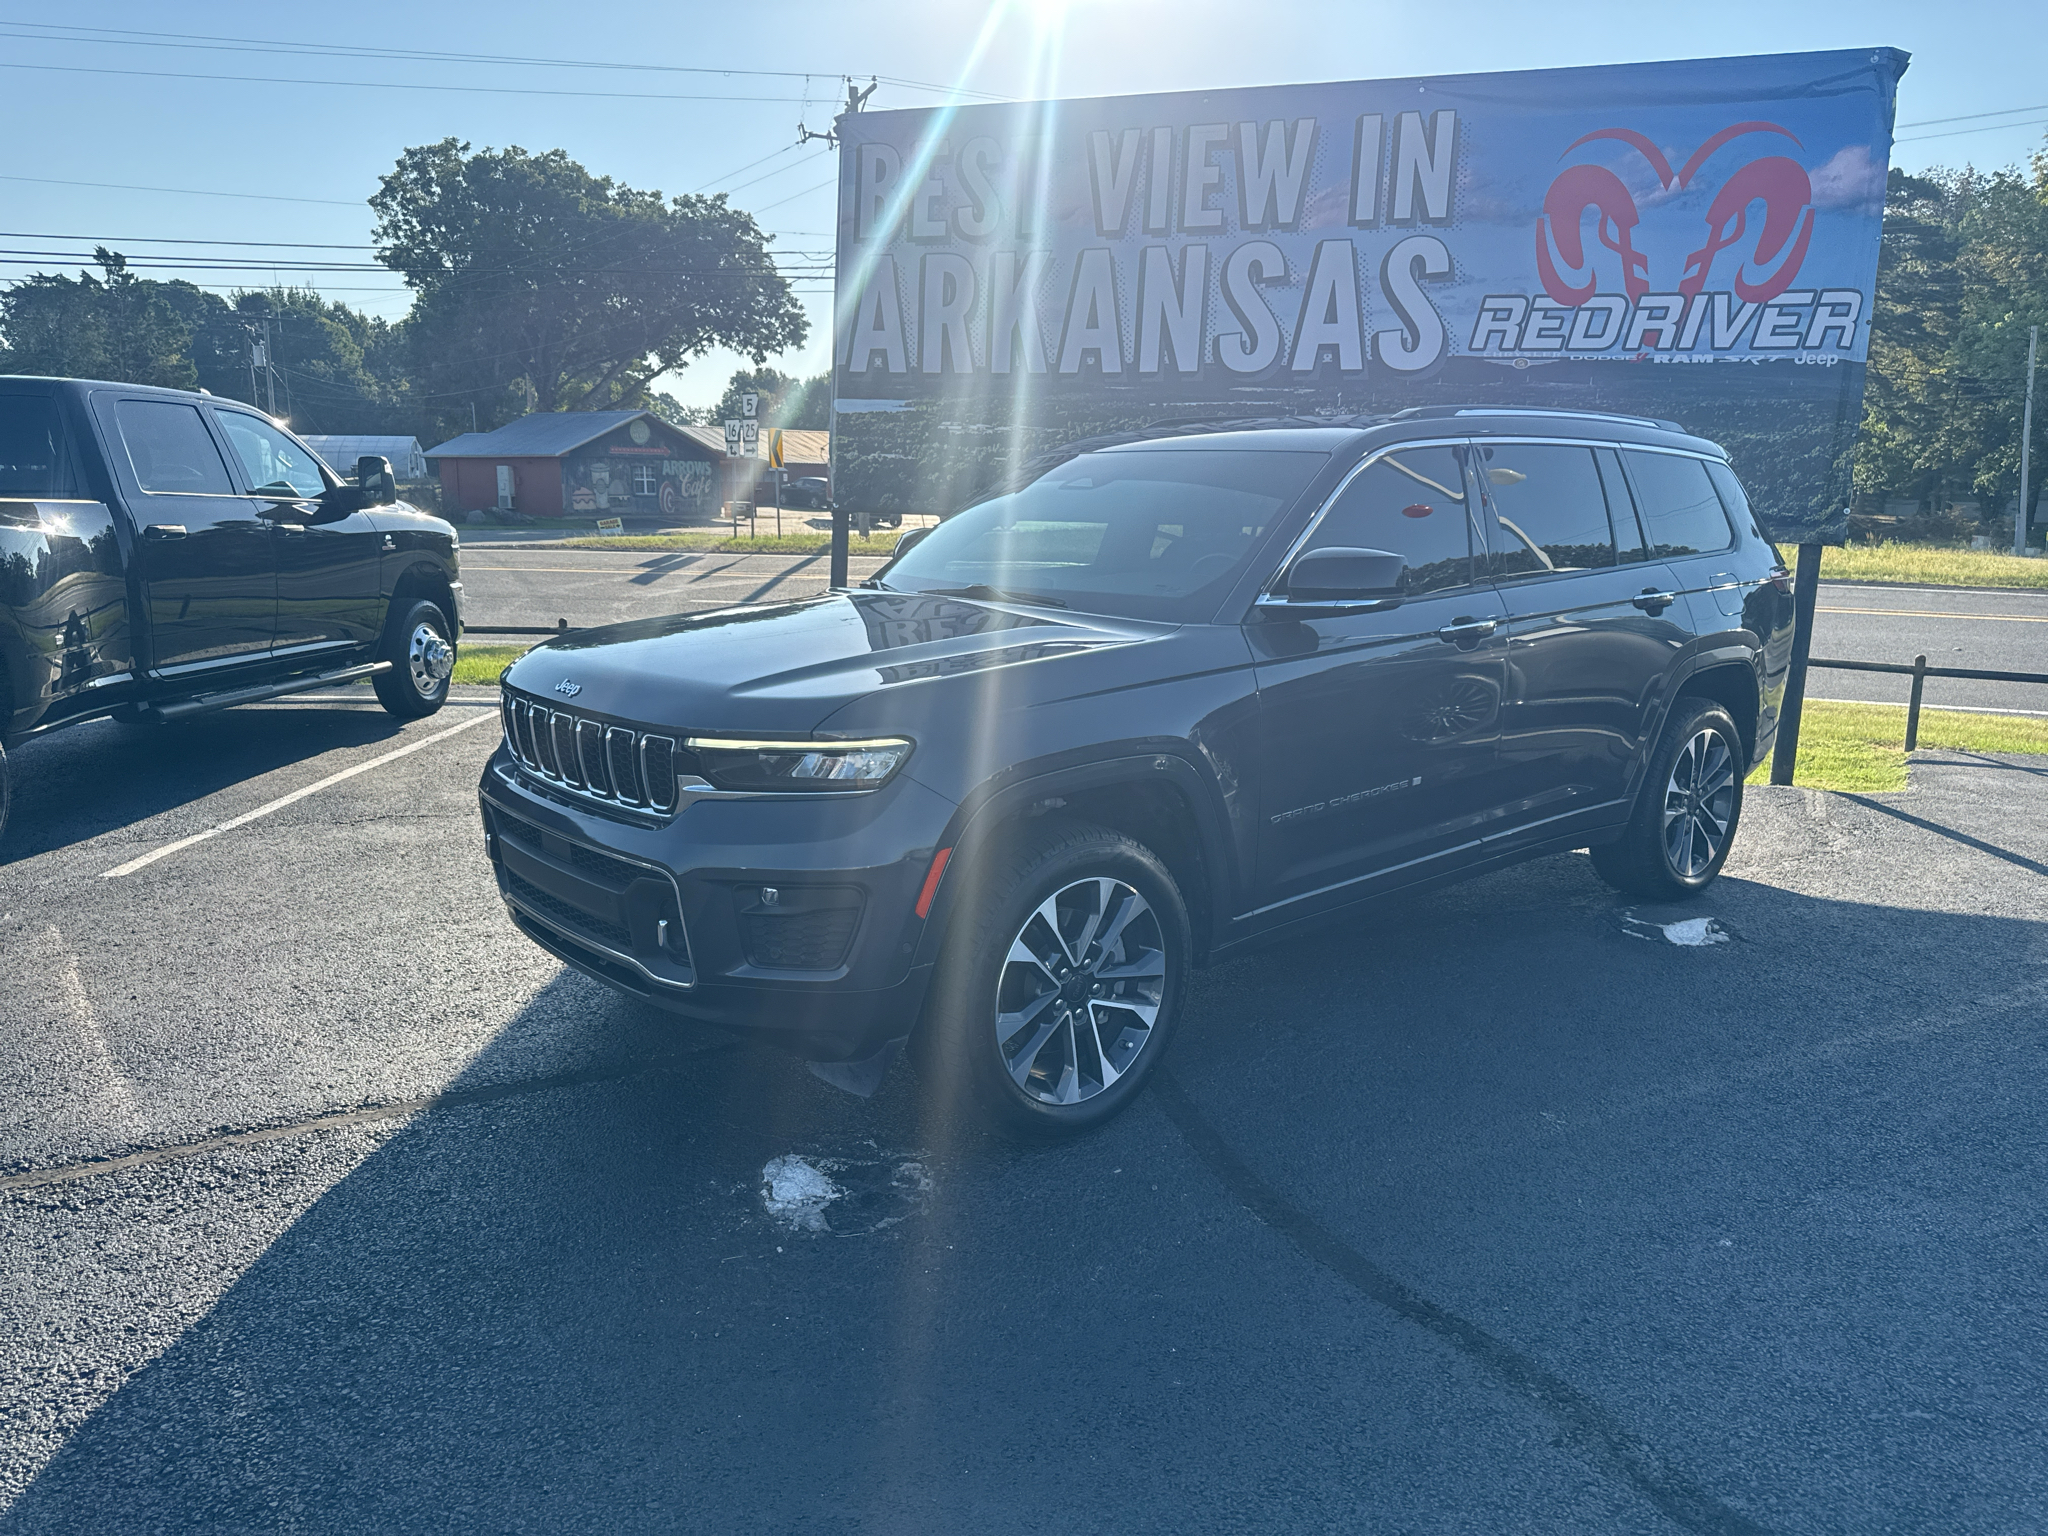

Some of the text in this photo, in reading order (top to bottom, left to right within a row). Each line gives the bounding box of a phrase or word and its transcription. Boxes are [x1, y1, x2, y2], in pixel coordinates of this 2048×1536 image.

[854, 109, 1457, 242] BEST VIEW IN
[846, 235, 1453, 376] ARKANSAS
[1468, 288, 1862, 351] REDRIVER
[1653, 354, 1714, 363] RAM
[1718, 354, 1788, 365] SRT
[1794, 351, 1839, 367] Jeep
[746, 398, 753, 412] 5
[728, 424, 737, 437] 16
[745, 424, 755, 437] 25
[662, 460, 712, 475] ARROWS
[555, 678, 581, 697] Jeep
[1270, 779, 1409, 824] GRAND CHEROKEE
